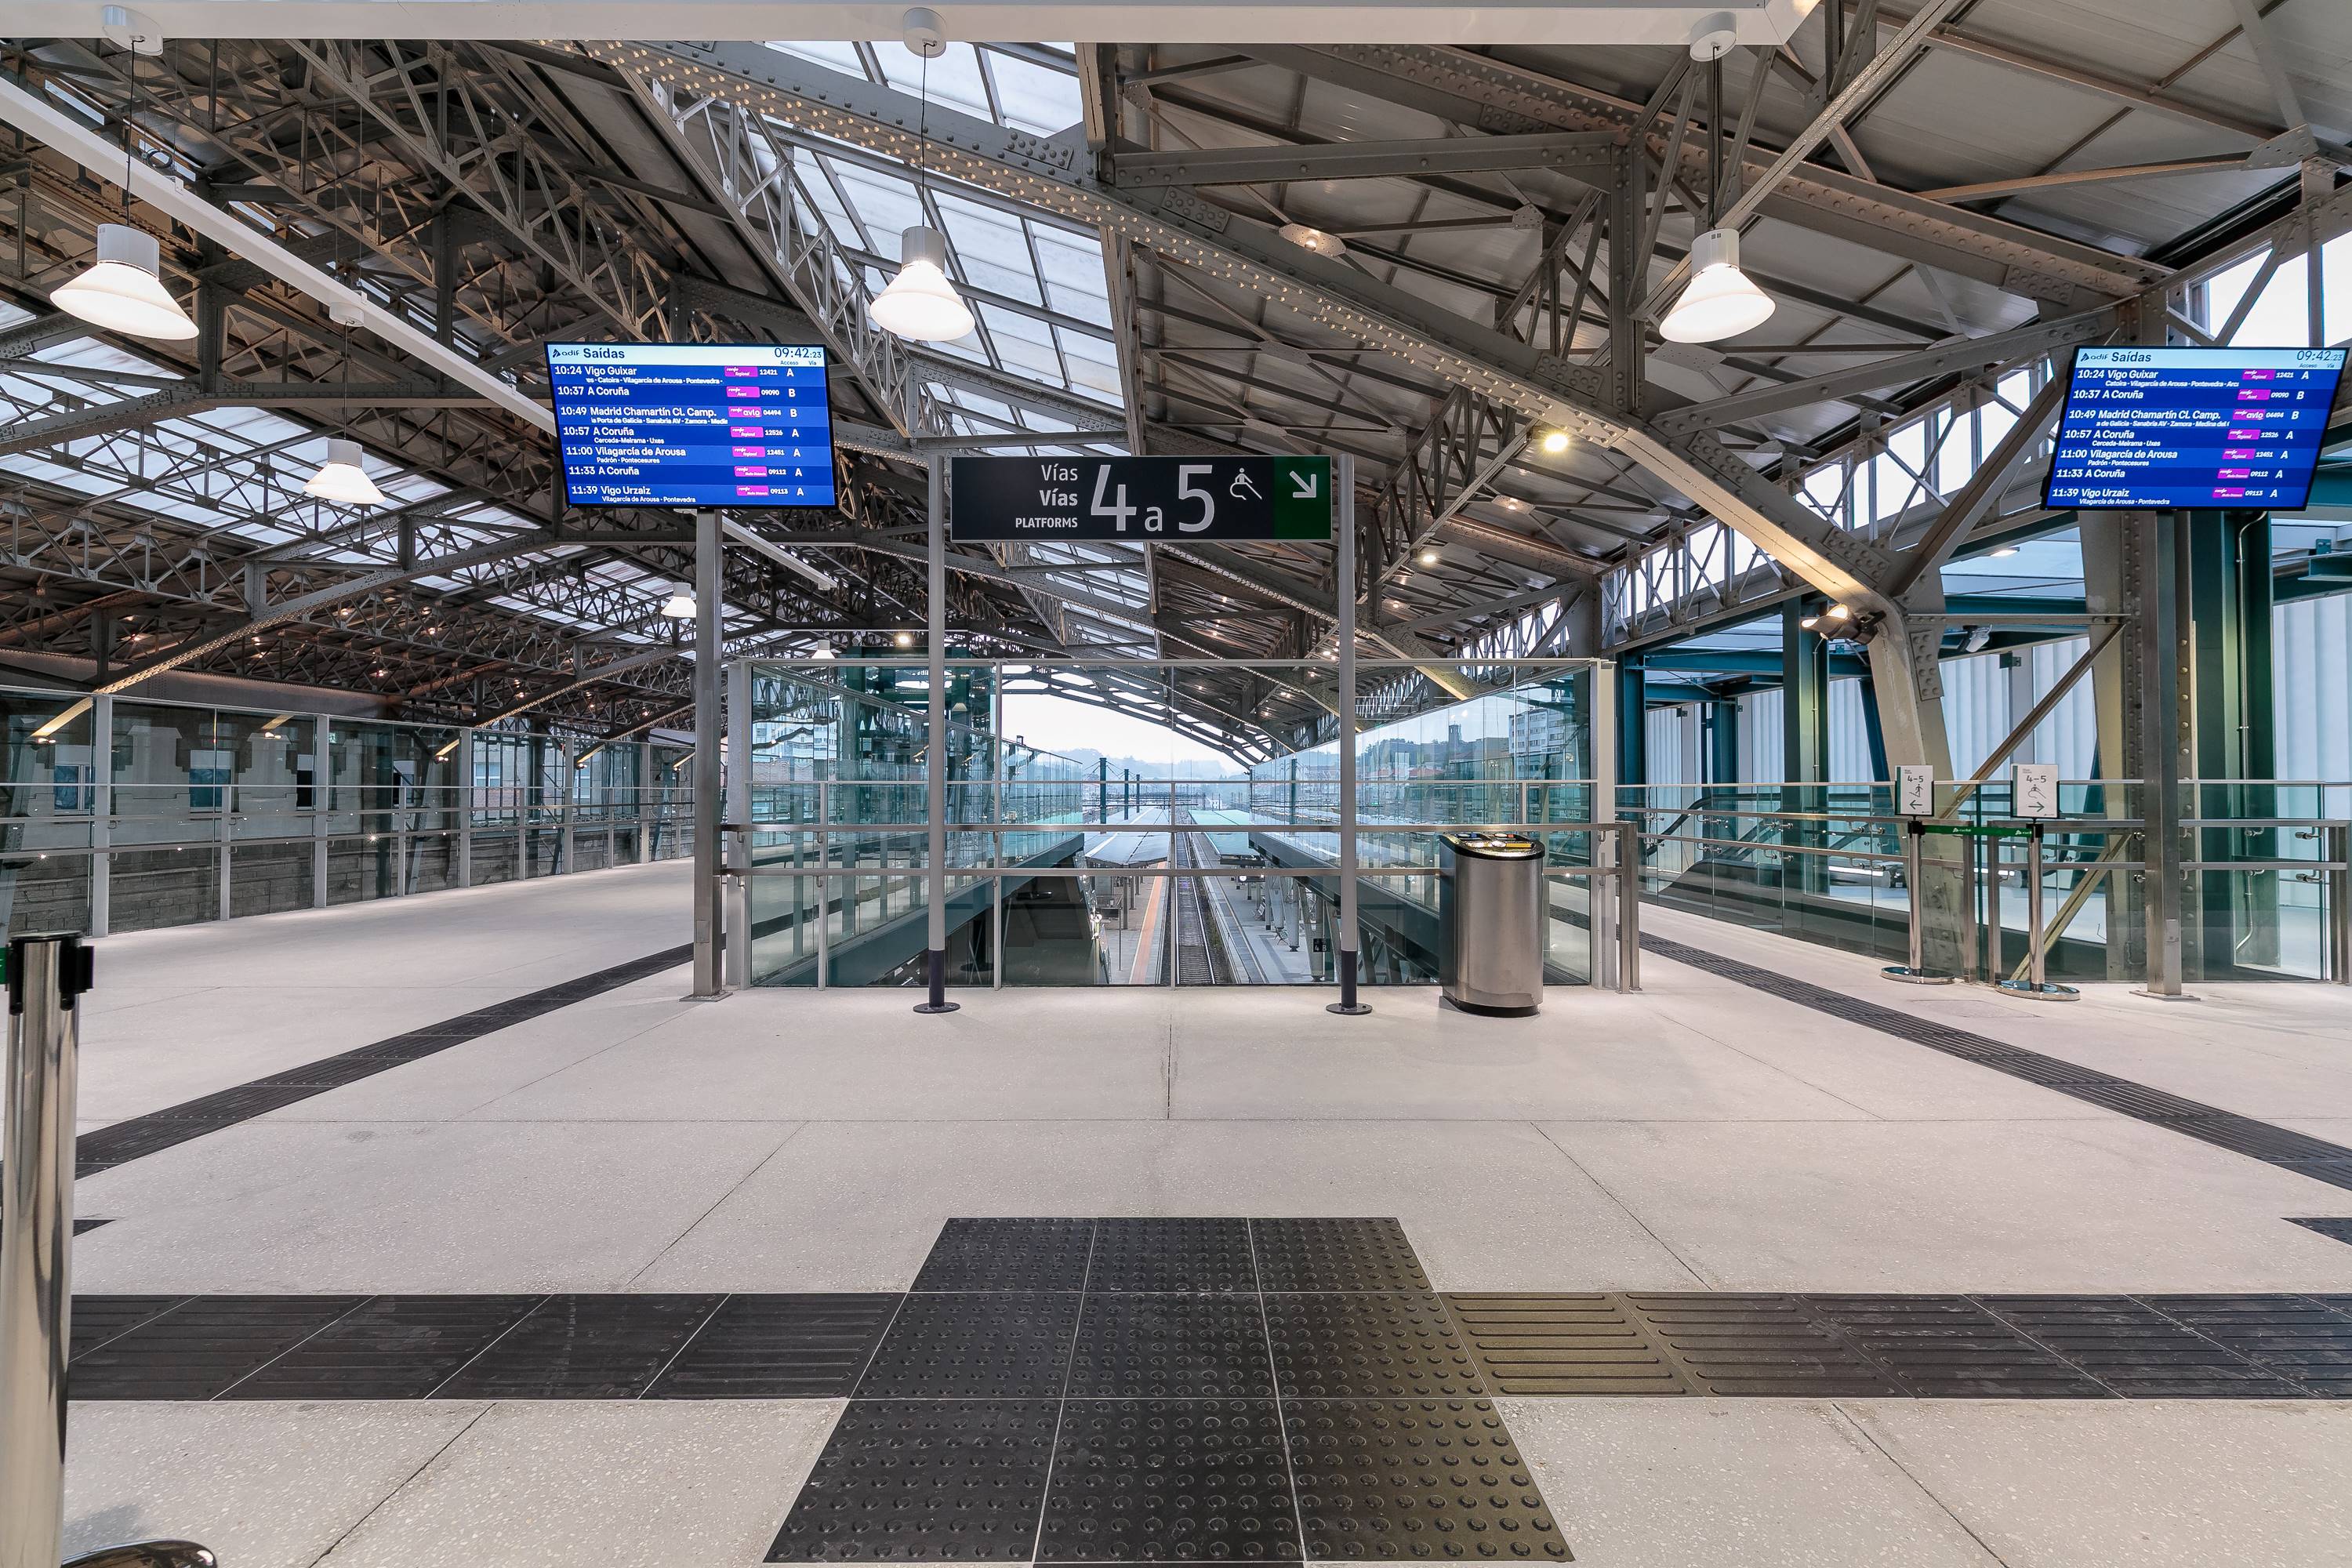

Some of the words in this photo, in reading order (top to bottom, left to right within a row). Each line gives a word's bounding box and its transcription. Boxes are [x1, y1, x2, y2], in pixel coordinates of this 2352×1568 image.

[584, 348, 625, 358] Saídas
[2111, 351, 2151, 362] Saídas
[555, 366, 582, 375] 10:24
[584, 366, 605, 376] Vigo
[607, 366, 637, 375] Guixar
[787, 368, 794, 377] A
[2077, 370, 2104, 378] 10:24
[2108, 370, 2127, 380] Vigo
[2129, 370, 2158, 378] Guixar
[558, 387, 584, 395] 10:37
[588, 387, 595, 395] A
[596, 387, 629, 396] Coruña
[2073, 390, 2100, 398] 10:37
[2111, 390, 2144, 399] Coruña
[2296, 391, 2304, 400] B
[561, 407, 587, 415] 10:49
[590, 407, 621, 416] Madrid
[623, 407, 670, 416] Chamartín
[687, 408, 717, 417] Camp.
[790, 409, 797, 417] B
[2069, 410, 2096, 418] 10:49
[2098, 410, 2130, 419] Madrid
[2131, 410, 2177, 419] Chamartín
[2192, 411, 2220, 421] Camp.
[2291, 411, 2299, 419] B
[563, 427, 589, 435] 10:57
[593, 427, 600, 435] A
[602, 427, 634, 436] Coruña
[2065, 430, 2092, 438] 10:57
[2102, 430, 2134, 439] Coruña
[566, 447, 592, 455] 11:00
[595, 447, 640, 457] Vilagarcía
[641, 447, 653, 456] de
[655, 448, 686, 456] Arousa
[793, 449, 801, 457] A
[2090, 450, 2132, 460] Vilagarcía
[2280, 450, 2288, 459] A
[569, 466, 595, 475] 11:33
[599, 466, 605, 475] A
[607, 466, 639, 475] Coruña
[795, 468, 802, 476] A
[1041, 463, 1078, 481] Vías
[2094, 469, 2125, 478] Coruña
[2275, 470, 2283, 478] A
[572, 486, 598, 494] 11:39
[600, 486, 621, 496] Vigo
[797, 487, 804, 496] A
[2082, 489, 2101, 498] Vigo
[1040, 489, 1078, 506] Vías
[1091, 465, 1136, 531] 4
[1145, 506, 1162, 531] a
[1178, 465, 1215, 532] 5
[1015, 517, 1078, 528] PLATFORMS
